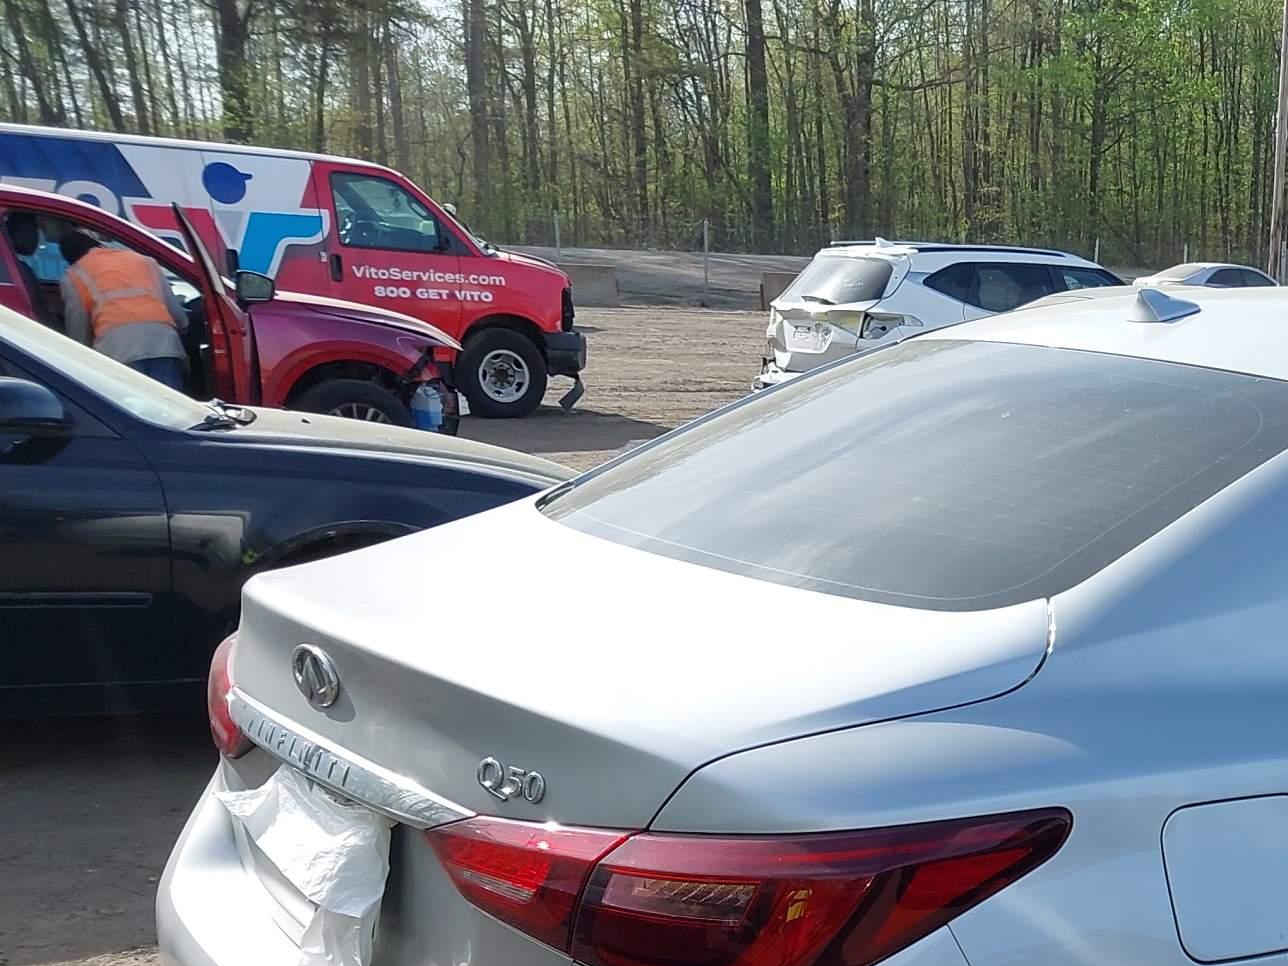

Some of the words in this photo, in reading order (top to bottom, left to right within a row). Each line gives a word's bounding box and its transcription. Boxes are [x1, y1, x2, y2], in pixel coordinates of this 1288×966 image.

[352, 265, 506, 286] VitoServices.com
[374, 285, 411, 298] 800
[415, 288, 449, 300] GET
[454, 290, 493, 302] VITO
[477, 756, 546, 804] Q50
